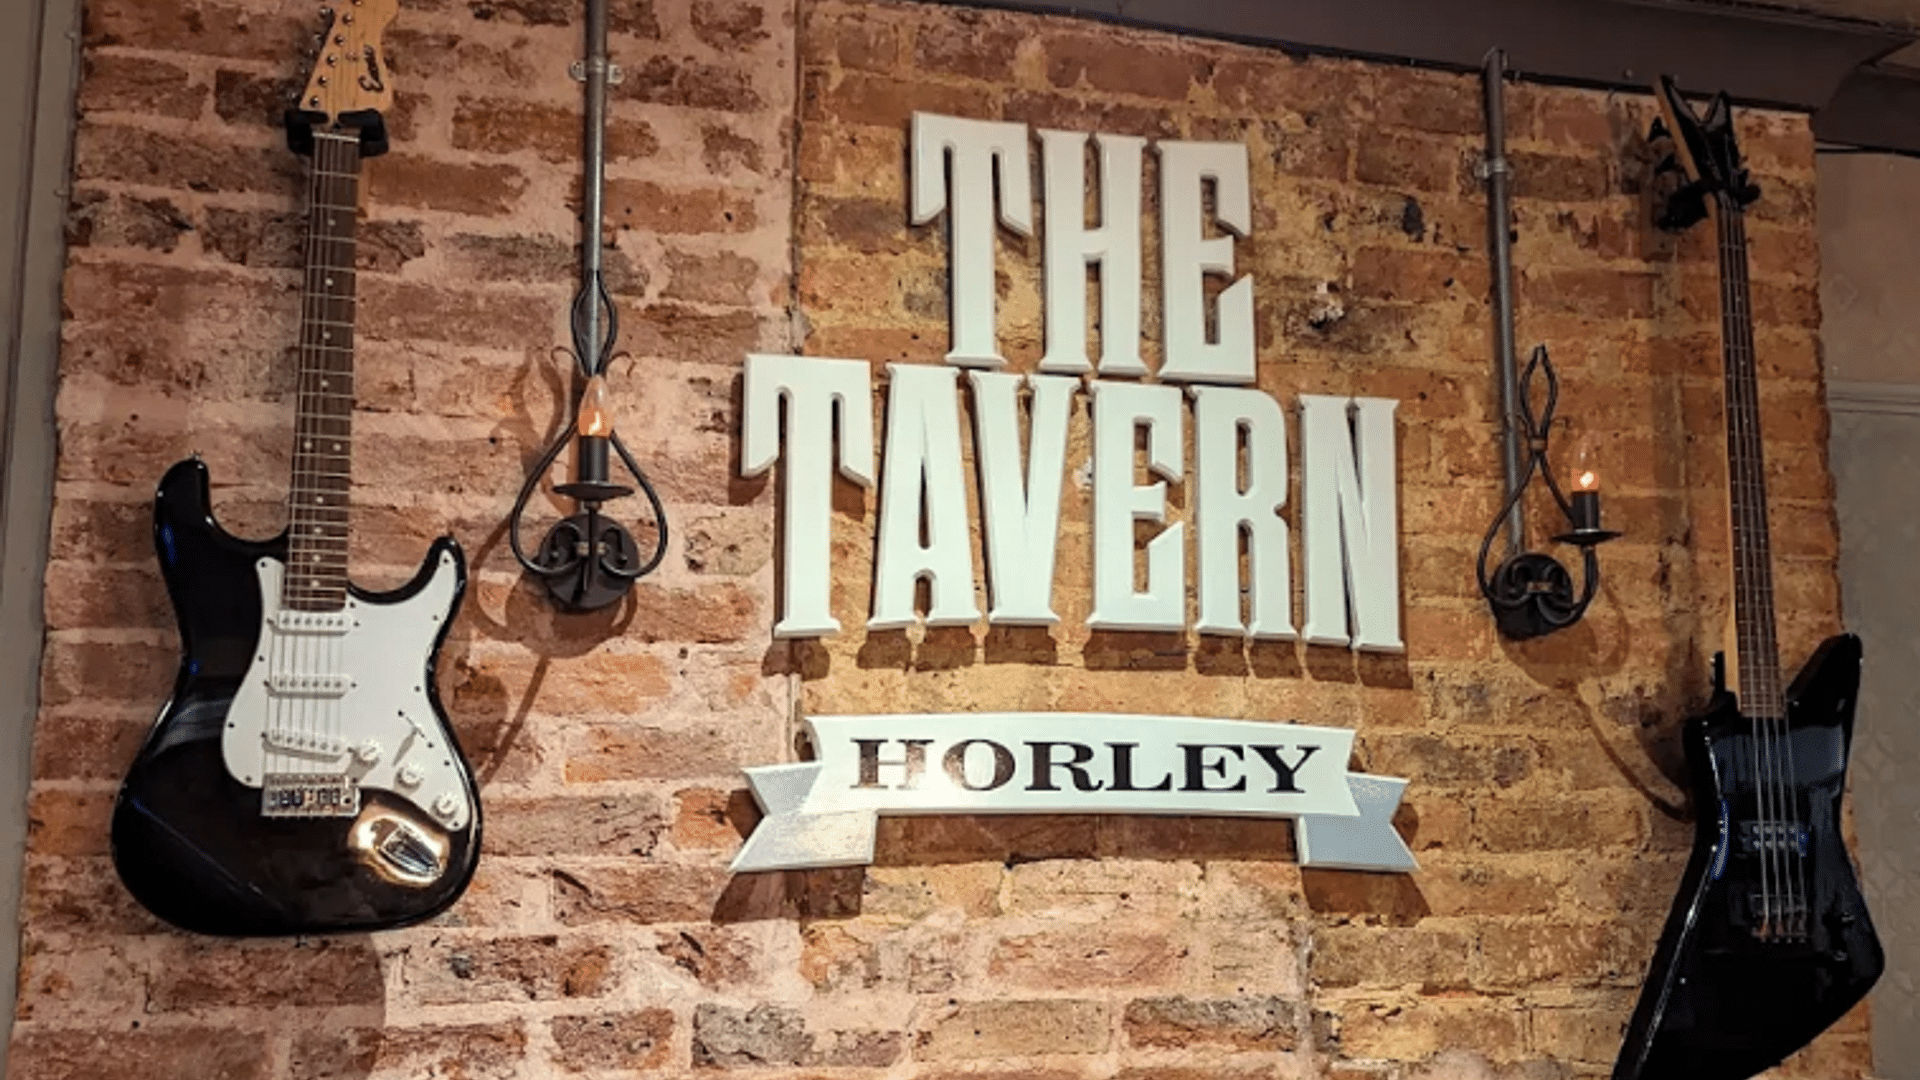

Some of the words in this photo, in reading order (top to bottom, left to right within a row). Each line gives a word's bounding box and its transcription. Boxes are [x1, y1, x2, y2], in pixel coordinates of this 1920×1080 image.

[911, 111, 1256, 384] THE
[741, 354, 1404, 652] TAVERN
[850, 738, 1321, 794] HORLEY
